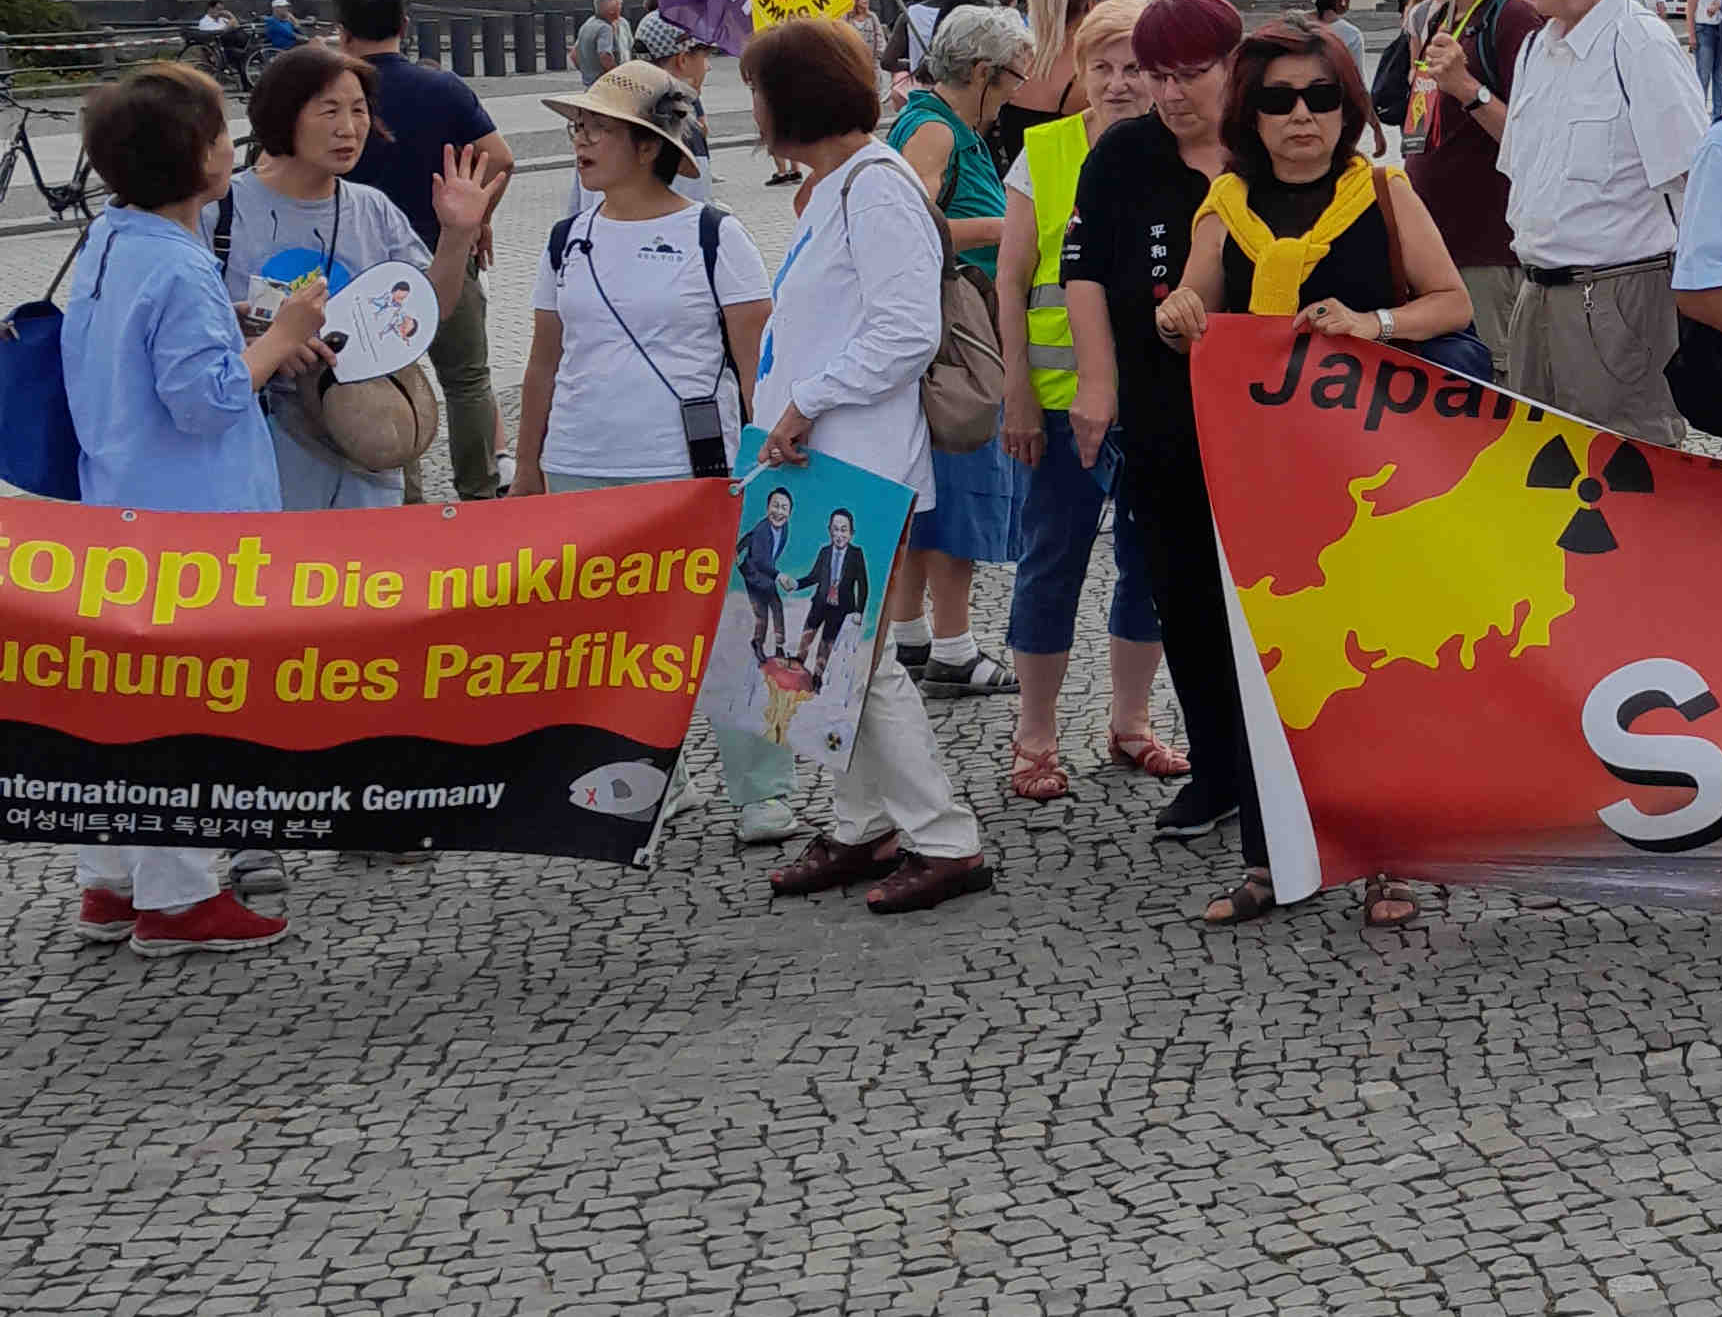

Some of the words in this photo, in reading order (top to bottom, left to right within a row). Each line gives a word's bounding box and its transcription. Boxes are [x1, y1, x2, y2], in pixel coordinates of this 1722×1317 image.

[290, 561, 404, 609] Die
[427, 543, 720, 611] nukleare
[275, 647, 400, 702] des
[423, 631, 705, 699] Pazifiks!
[211, 784, 351, 811] Network
[362, 782, 505, 811] Germany
[6, 808, 164, 834] 여성네트워크
[171, 815, 273, 838] 독일지역
[282, 818, 333, 839] 본부
